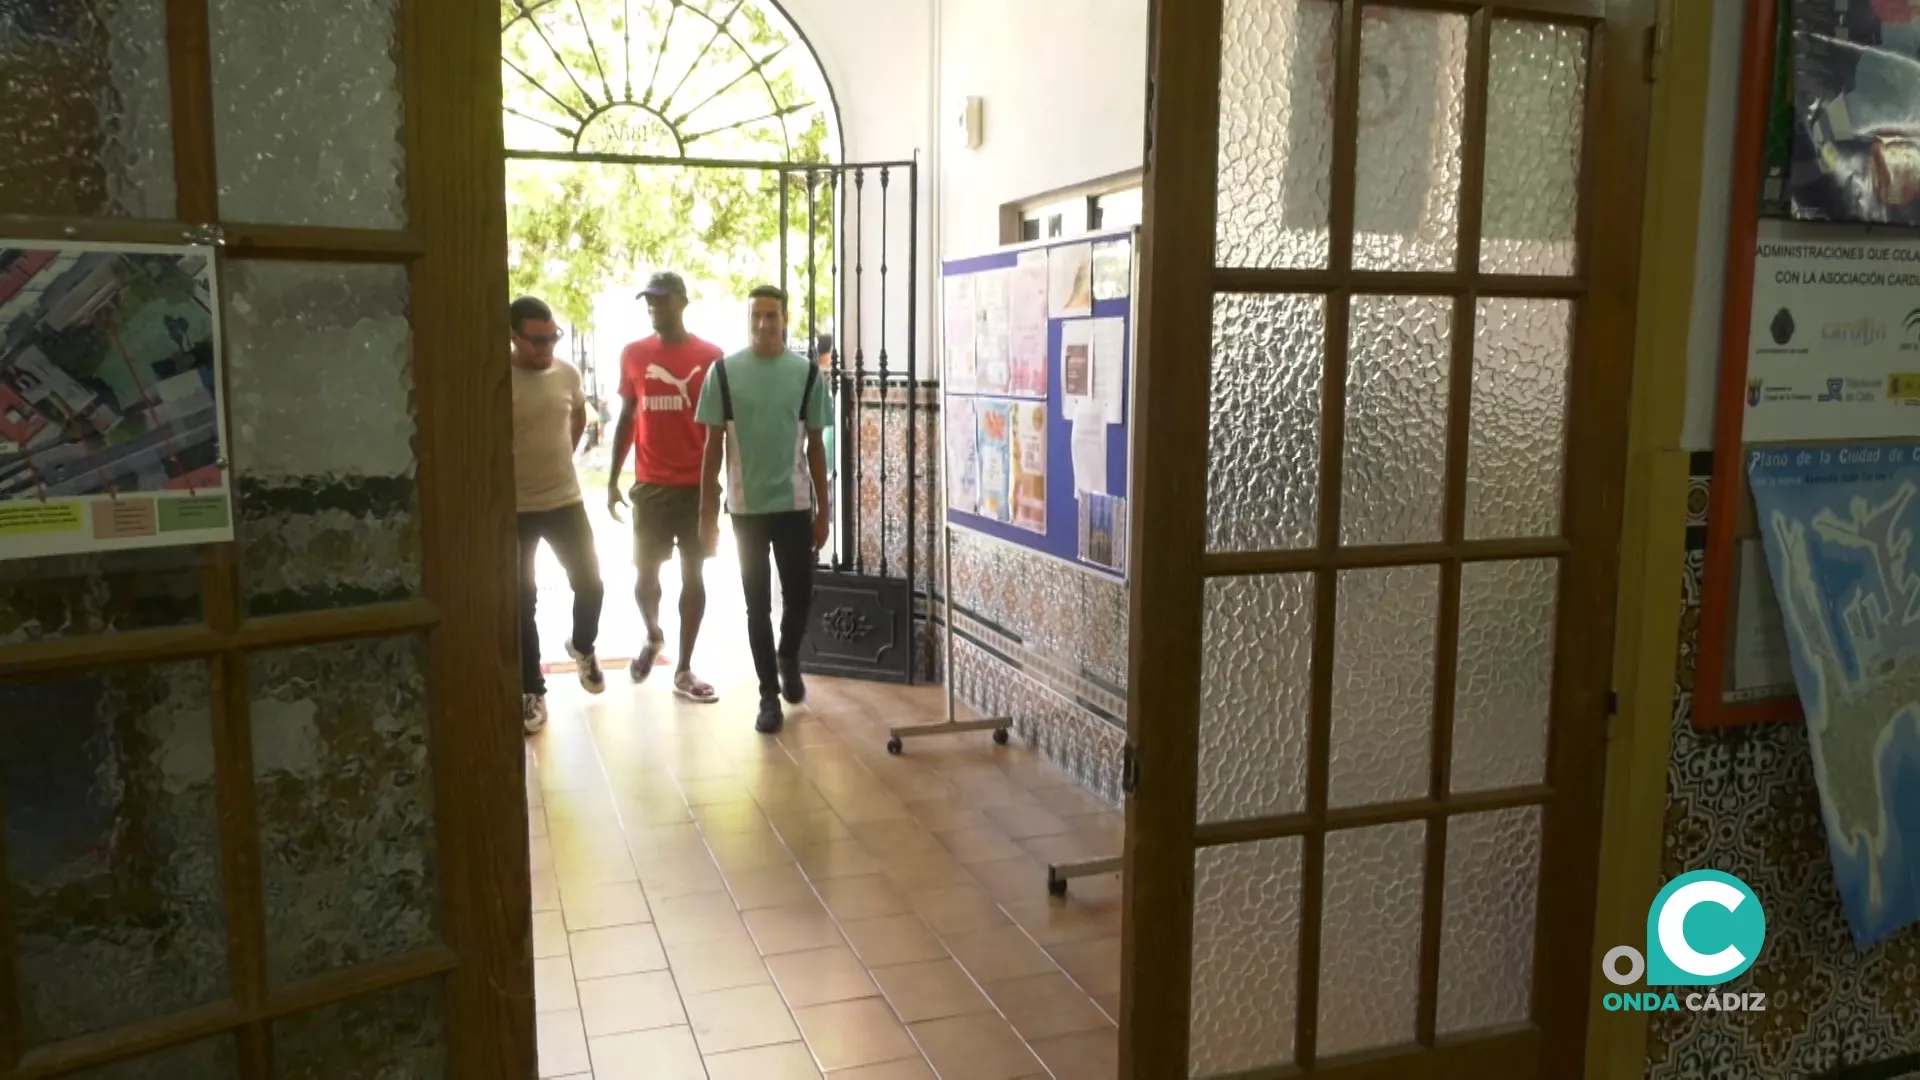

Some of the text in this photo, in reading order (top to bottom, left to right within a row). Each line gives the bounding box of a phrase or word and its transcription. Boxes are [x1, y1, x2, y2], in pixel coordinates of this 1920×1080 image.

[1756, 245, 1864, 260] ADMINISTRACIONES
[1867, 246, 1889, 260] QUE
[1775, 271, 1800, 285] CON
[1803, 272, 1817, 285] LA
[1818, 271, 1885, 286] ASOCIACIÓN
[642, 395, 683, 412] PUMA
[1750, 451, 1788, 469] Plano
[1797, 450, 1812, 467] de
[1820, 449, 1831, 465] la
[1839, 448, 1881, 465] Ciudad
[1888, 447, 1904, 463] de
